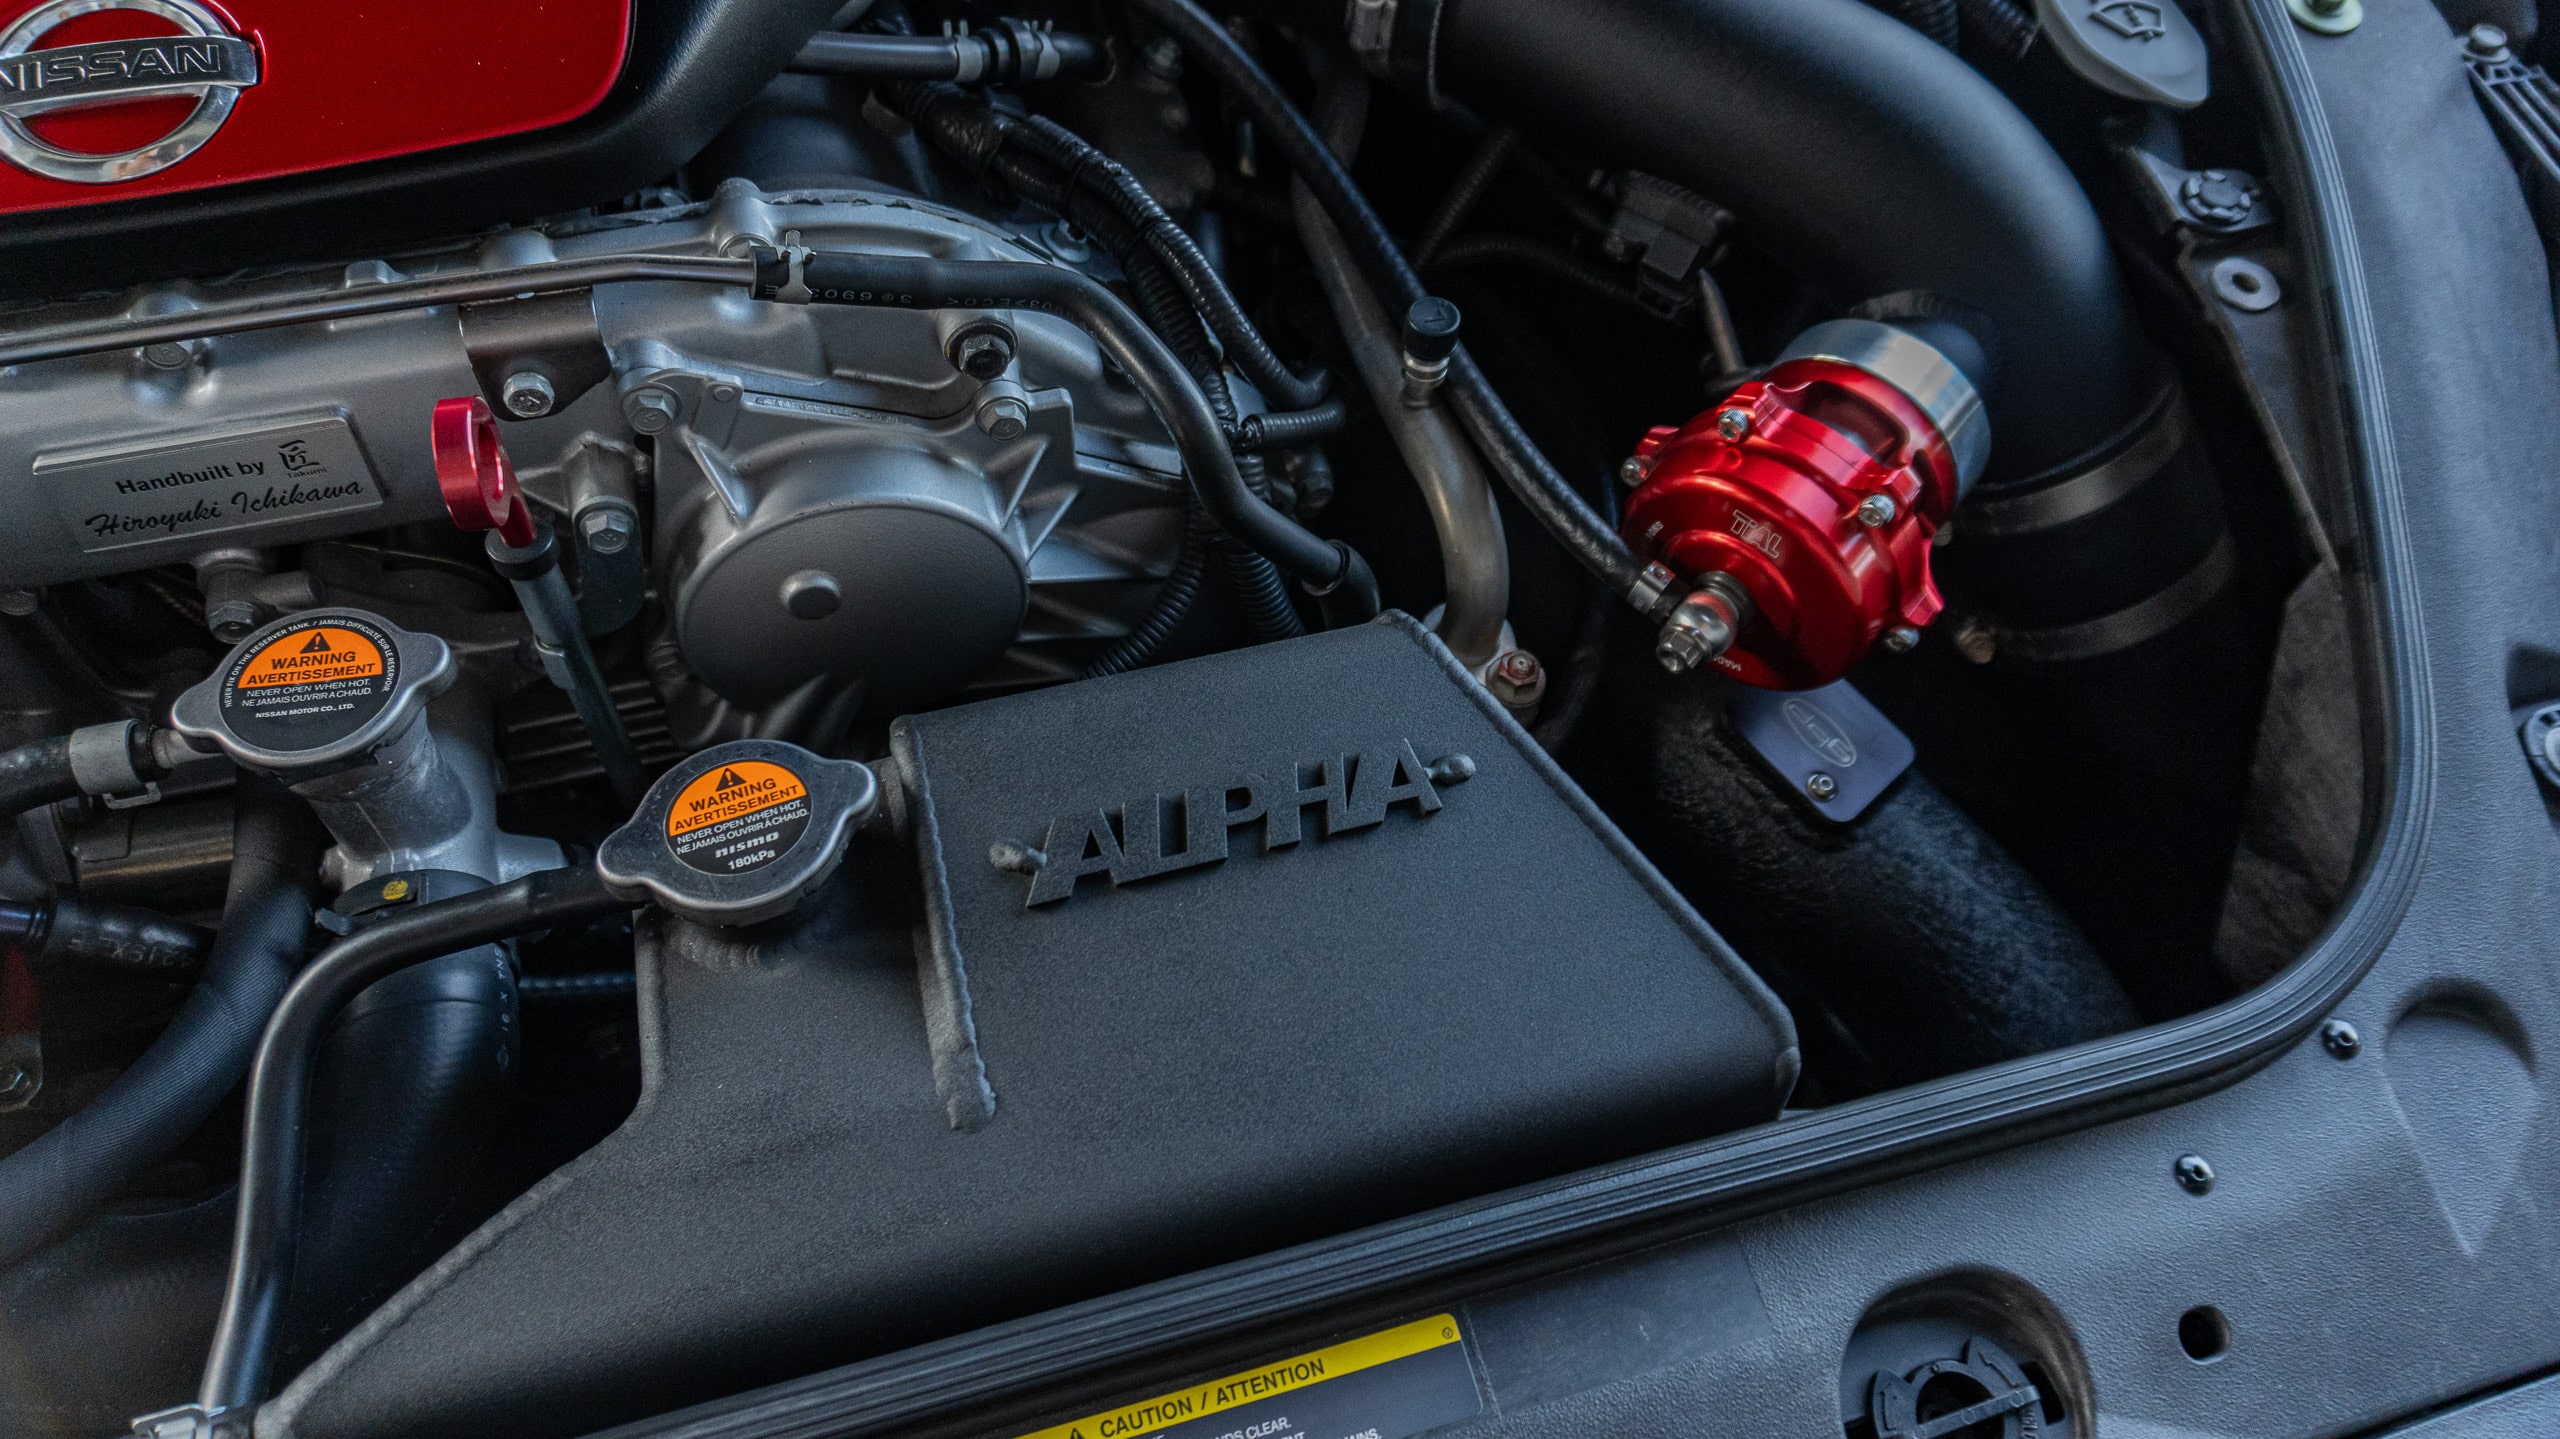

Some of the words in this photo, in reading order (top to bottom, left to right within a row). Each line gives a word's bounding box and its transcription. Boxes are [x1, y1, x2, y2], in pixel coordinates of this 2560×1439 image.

[115, 462, 234, 495] Handbuilt
[237, 460, 265, 477] by
[286, 466, 328, 479] Takumi
[84, 500, 223, 538] Hiroyuki
[231, 481, 364, 514] Ichikawa
[231, 665, 242, 676] ON
[238, 653, 253, 665] THE
[249, 629, 288, 654] RESERVER
[318, 619, 346, 627] JAMAIS
[377, 637, 390, 650] SUR
[271, 651, 356, 670] WARNING
[246, 662, 376, 686] AVERTISSEMENT
[1713, 657, 1742, 672] MAD
[241, 699, 256, 707] NE
[255, 695, 290, 706] JAMAIS
[291, 691, 328, 702] OUVRIR
[246, 687, 281, 698] NEVER
[282, 685, 312, 695] OPEN
[314, 681, 347, 691] WHEN
[348, 678, 372, 688] HOT.
[255, 710, 288, 719] NISSAN
[288, 707, 320, 716] MOTOR
[337, 702, 356, 711] LTD.
[674, 785, 798, 831] AVERTISSEMENT
[689, 778, 777, 813] WARNING
[676, 846, 691, 855] NE
[691, 833, 726, 850] JAMAIS
[726, 823, 764, 840] OUVRIR
[771, 808, 809, 826] CHAUD.
[677, 828, 713, 844] NEVER
[713, 818, 744, 833] OPEN
[744, 808, 778, 824] WHEN
[779, 800, 804, 814] HOT.
[1026, 738, 1443, 909] ALPHA
[715, 831, 779, 858] nismo
[728, 849, 776, 870] 180kPa
[1100, 1397, 1193, 1438] CAUTION
[1201, 1391, 1208, 1411] /
[1216, 1358, 1325, 1406] ATTENTION
[1245, 1416, 1292, 1439] CLEAR.
